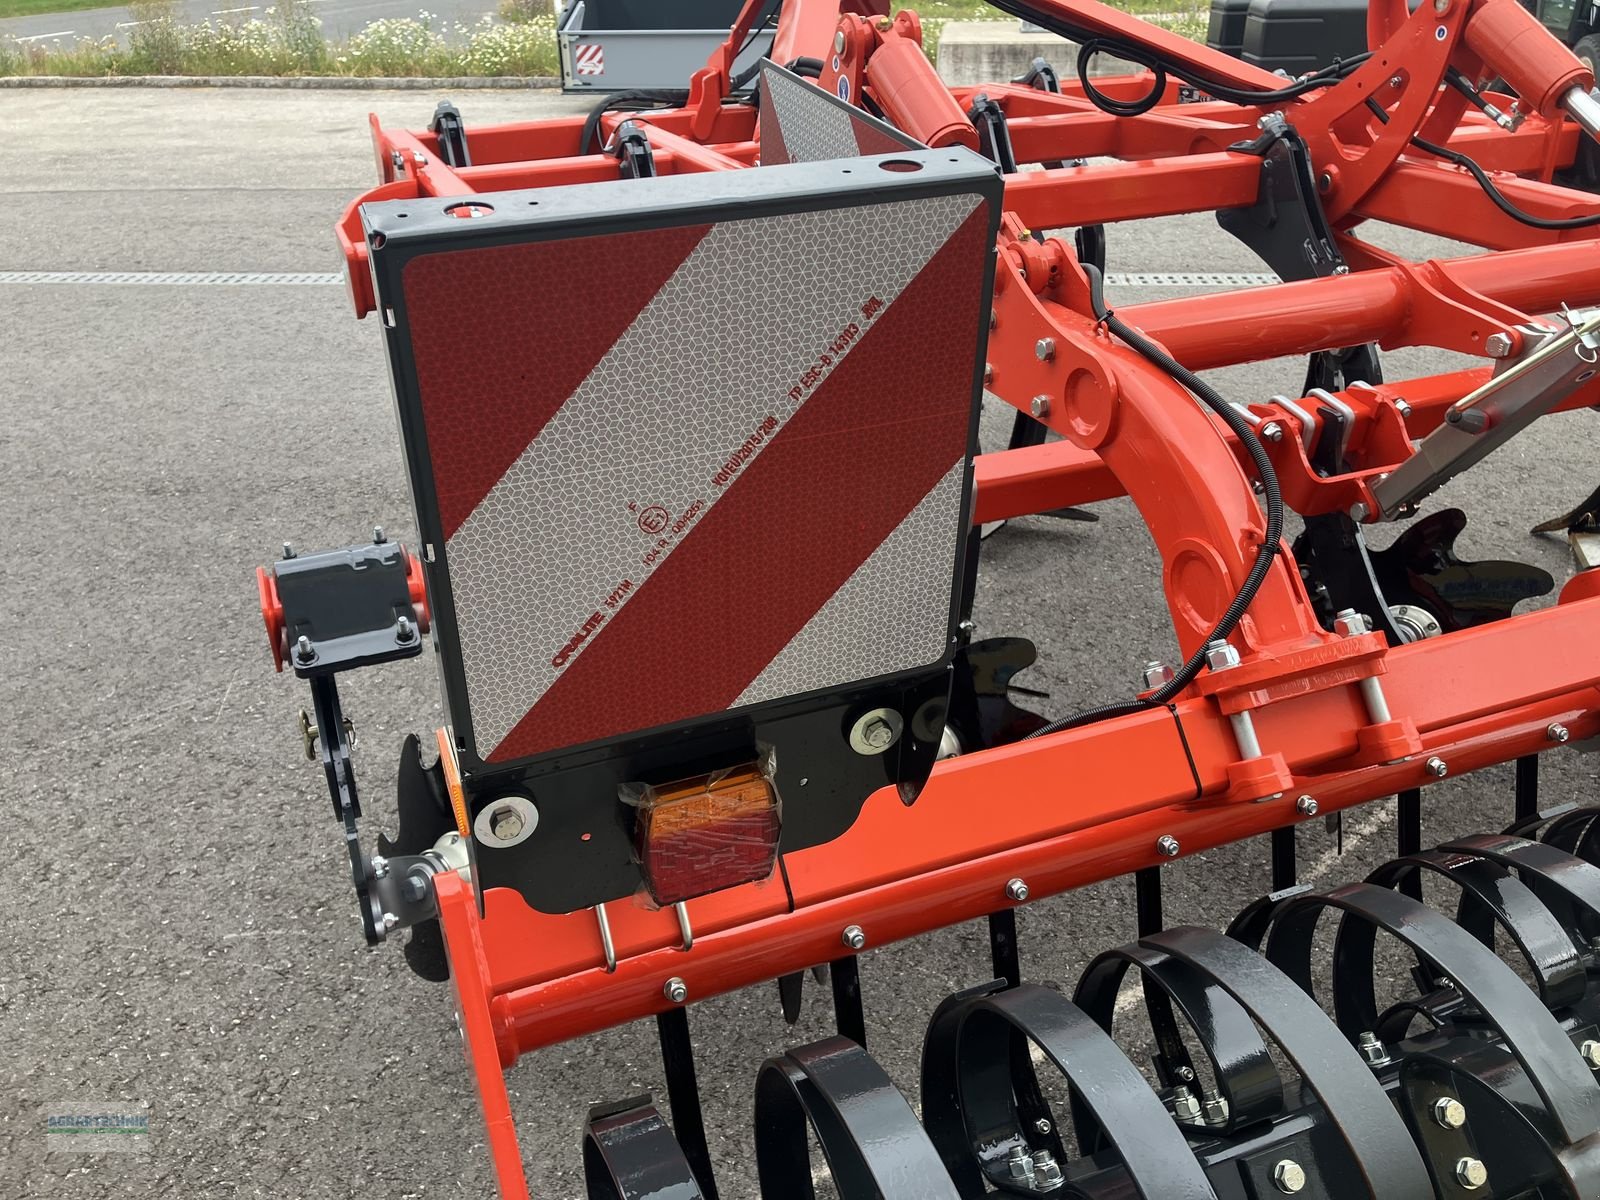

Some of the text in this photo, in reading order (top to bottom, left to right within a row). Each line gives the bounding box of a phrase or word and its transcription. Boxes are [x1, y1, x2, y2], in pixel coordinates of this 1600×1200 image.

[788, 323, 860, 401] TP ESC-B 14303
[642, 548, 661, 566] 104
[658, 539, 670, 549] R
[551, 579, 634, 668] ORALITE 5921M
